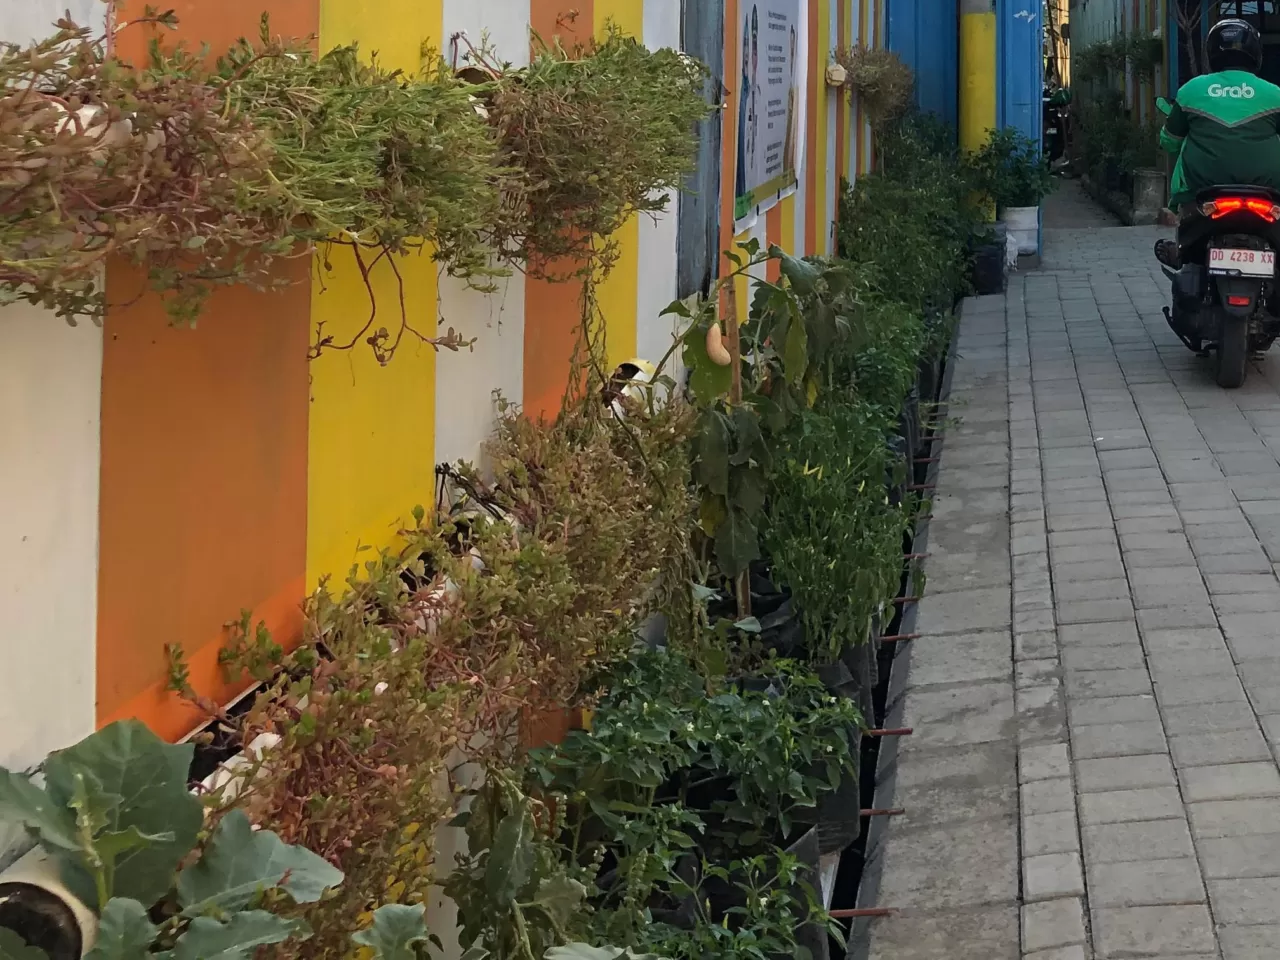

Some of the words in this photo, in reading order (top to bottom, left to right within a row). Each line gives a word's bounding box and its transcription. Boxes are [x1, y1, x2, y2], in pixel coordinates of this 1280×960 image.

[1207, 83, 1255, 99] Grab
[1211, 250, 1224, 261] DD
[1230, 251, 1255, 263] 4238
[1260, 253, 1273, 264] XX
